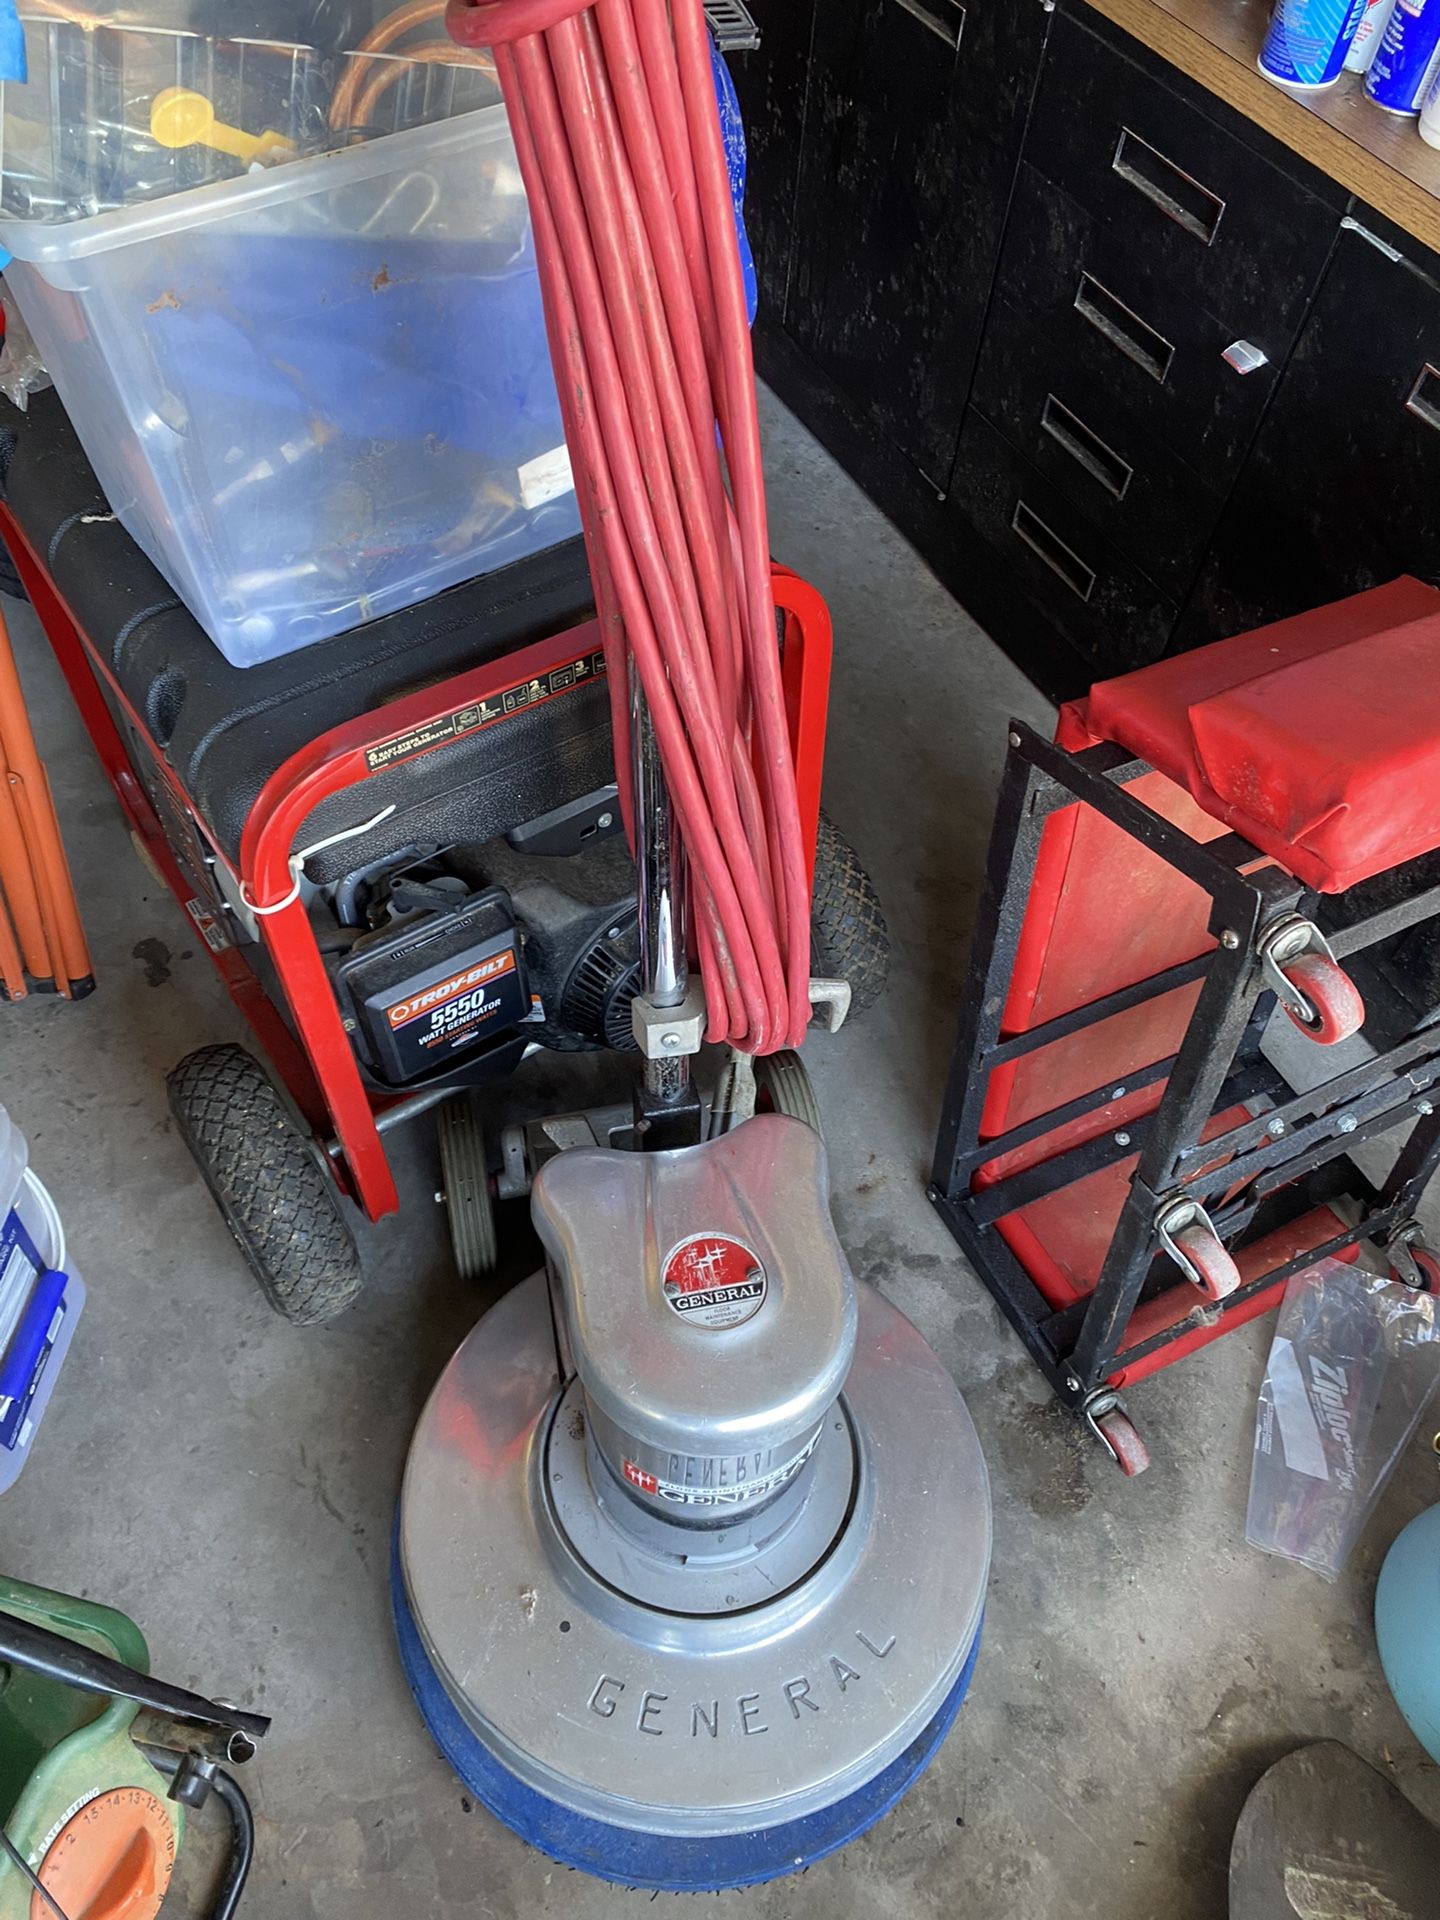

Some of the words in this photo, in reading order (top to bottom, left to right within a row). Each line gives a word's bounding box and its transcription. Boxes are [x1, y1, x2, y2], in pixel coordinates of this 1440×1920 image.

[575, 660, 585, 672] 3
[529, 680, 540, 692] 2
[479, 702, 487, 712] 1
[393, 747, 414, 759] YOUR
[413, 726, 454, 748] GENERATOR
[398, 737, 420, 750] STEPS
[420, 732, 431, 741] TO
[410, 955, 509, 1012] TROY-BILT
[418, 1027, 446, 1046] WATT
[447, 998, 502, 1031] GENERATOR
[430, 989, 485, 1030] 5550
[676, 1285, 761, 1309] GENERAL
[1308, 1355, 1351, 1443] Ziploc
[586, 1629, 896, 1738] GENERAL
[38, 1823, 62, 1853] RATE
[60, 1787, 100, 1823] SETTING
[83, 1807, 99, 1824] 15
[106, 1794, 120, 1808] 14
[129, 1792, 141, 1804] 13
[146, 1796, 157, 1812] 12
[158, 1810, 169, 1826] 11
[166, 1834, 174, 1851] 10
[66, 1833, 76, 1845] 2
